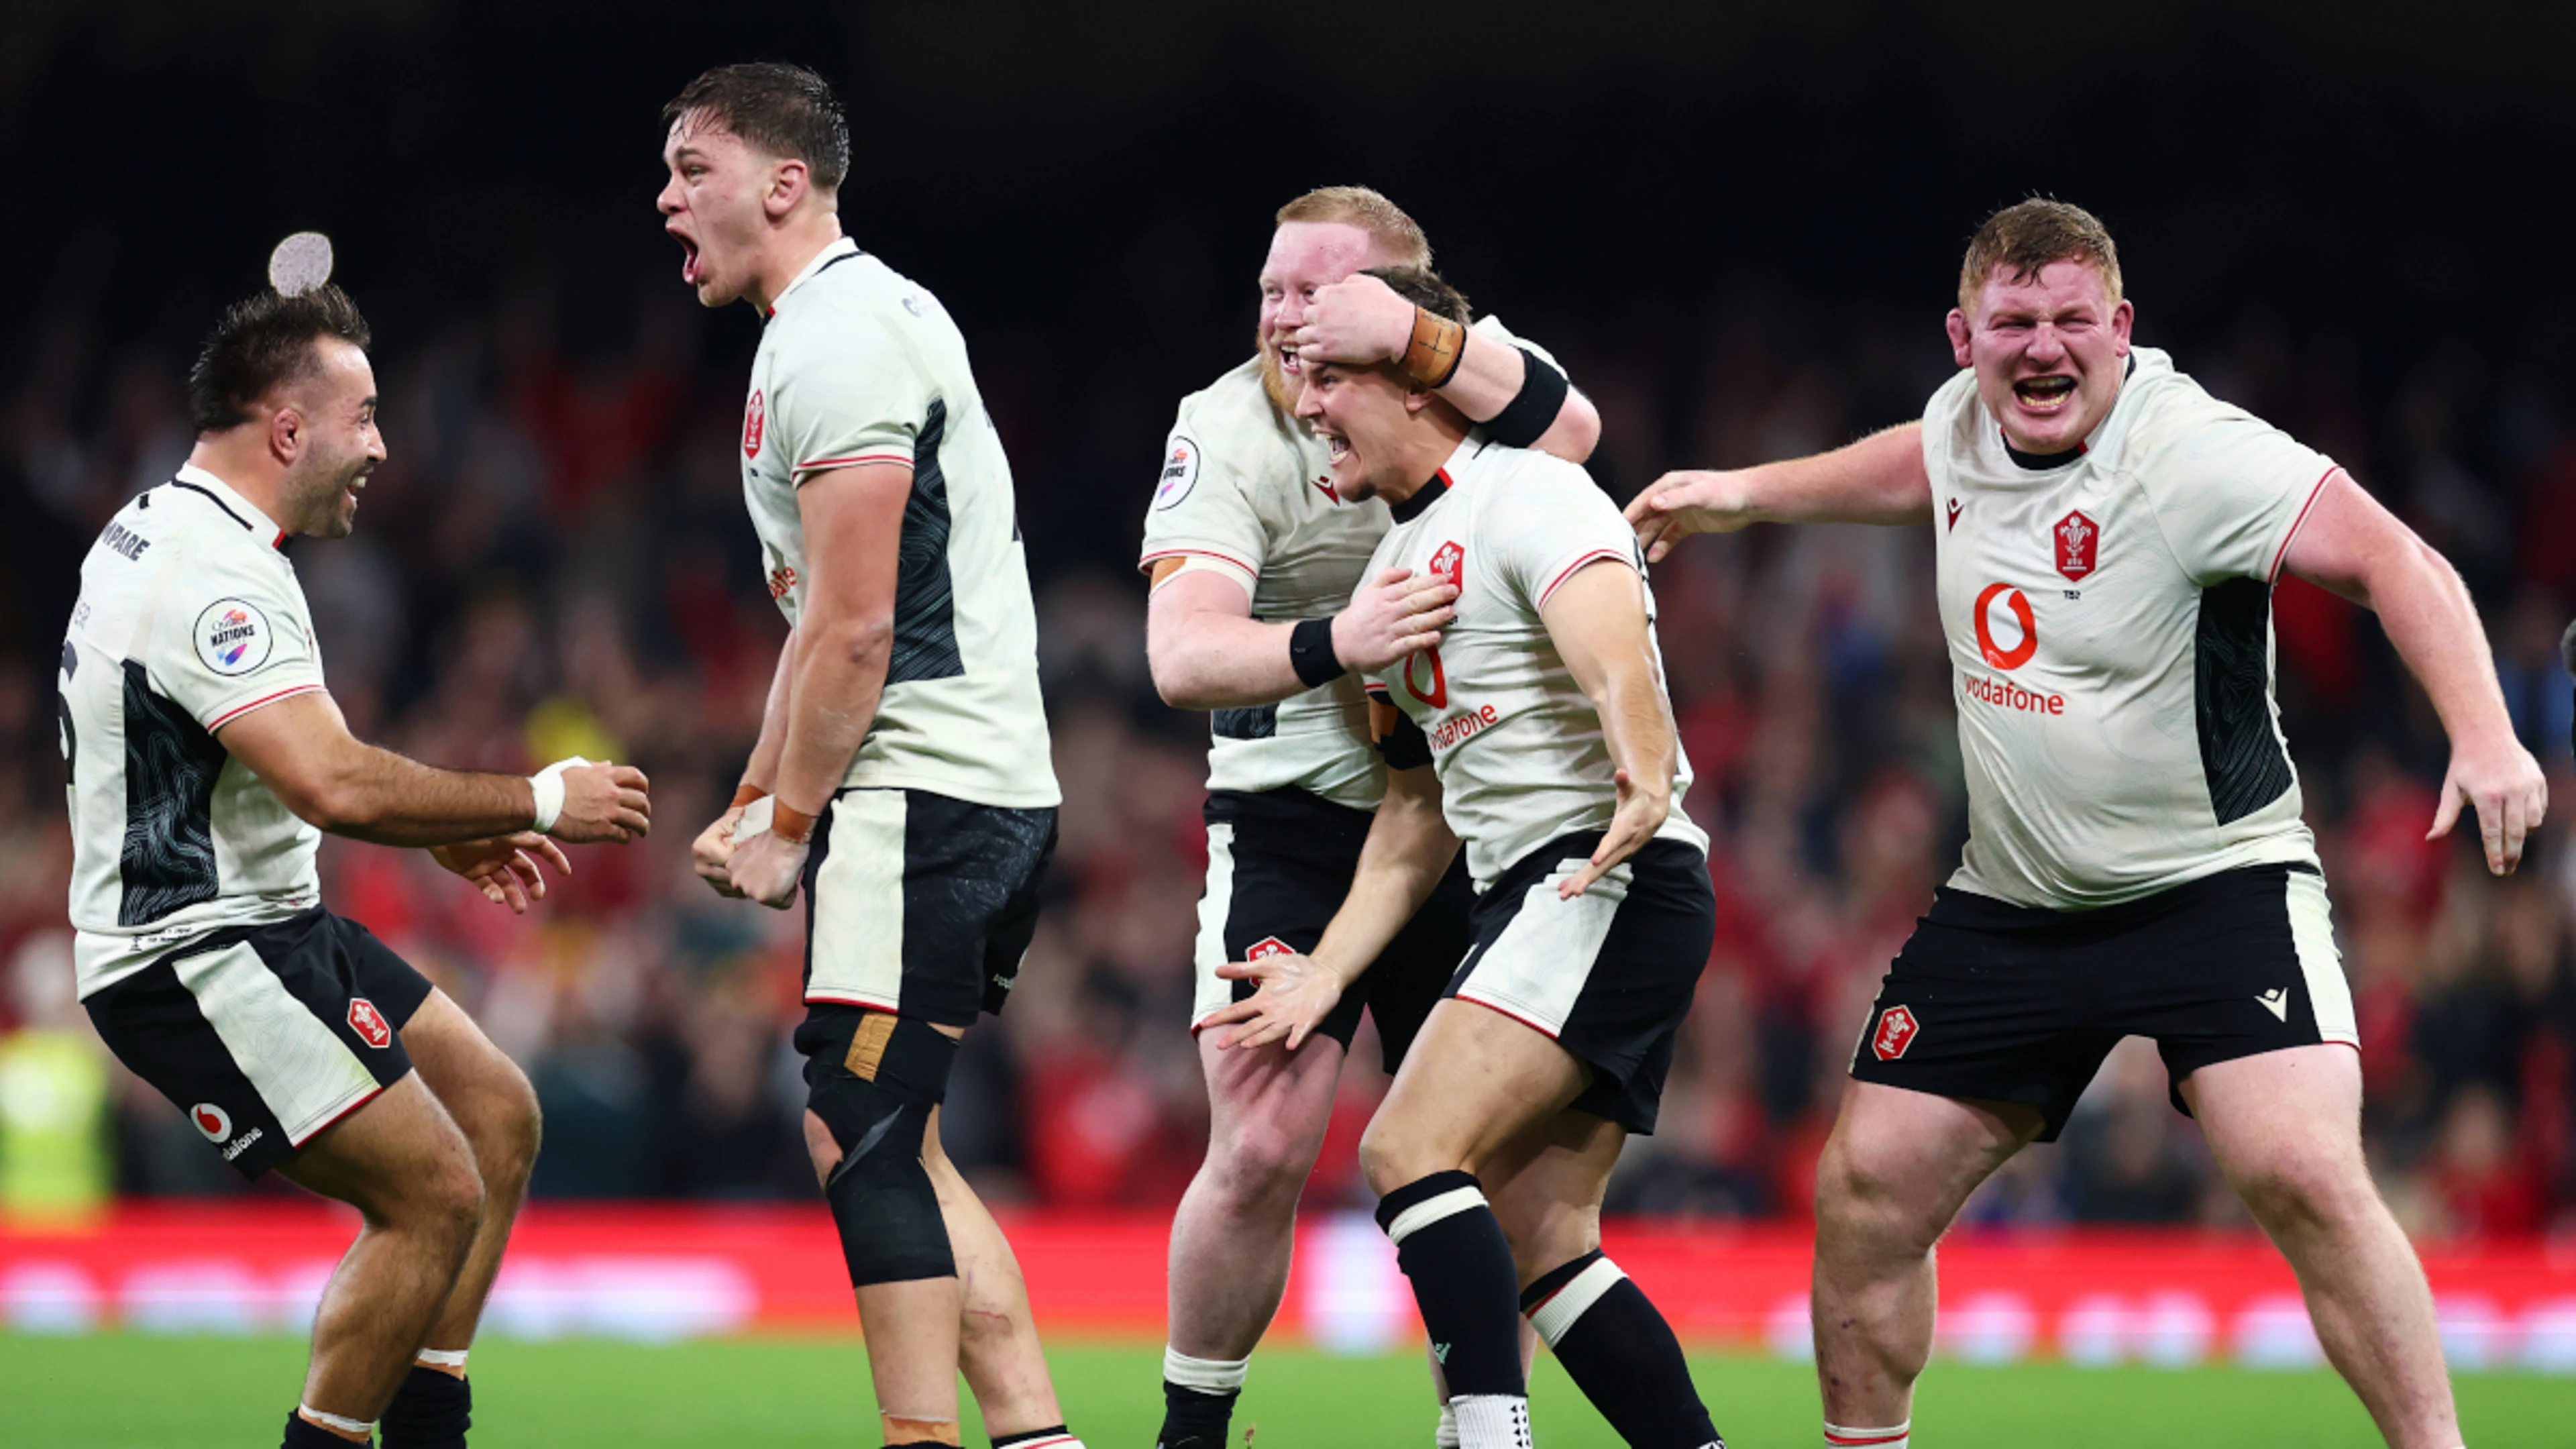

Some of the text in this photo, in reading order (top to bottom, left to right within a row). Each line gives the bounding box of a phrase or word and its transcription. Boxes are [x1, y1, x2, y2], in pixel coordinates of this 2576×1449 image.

[210, 624, 255, 647] NATIONS
[1964, 676, 2063, 715] vodafone
[223, 1126, 263, 1162] dafone
